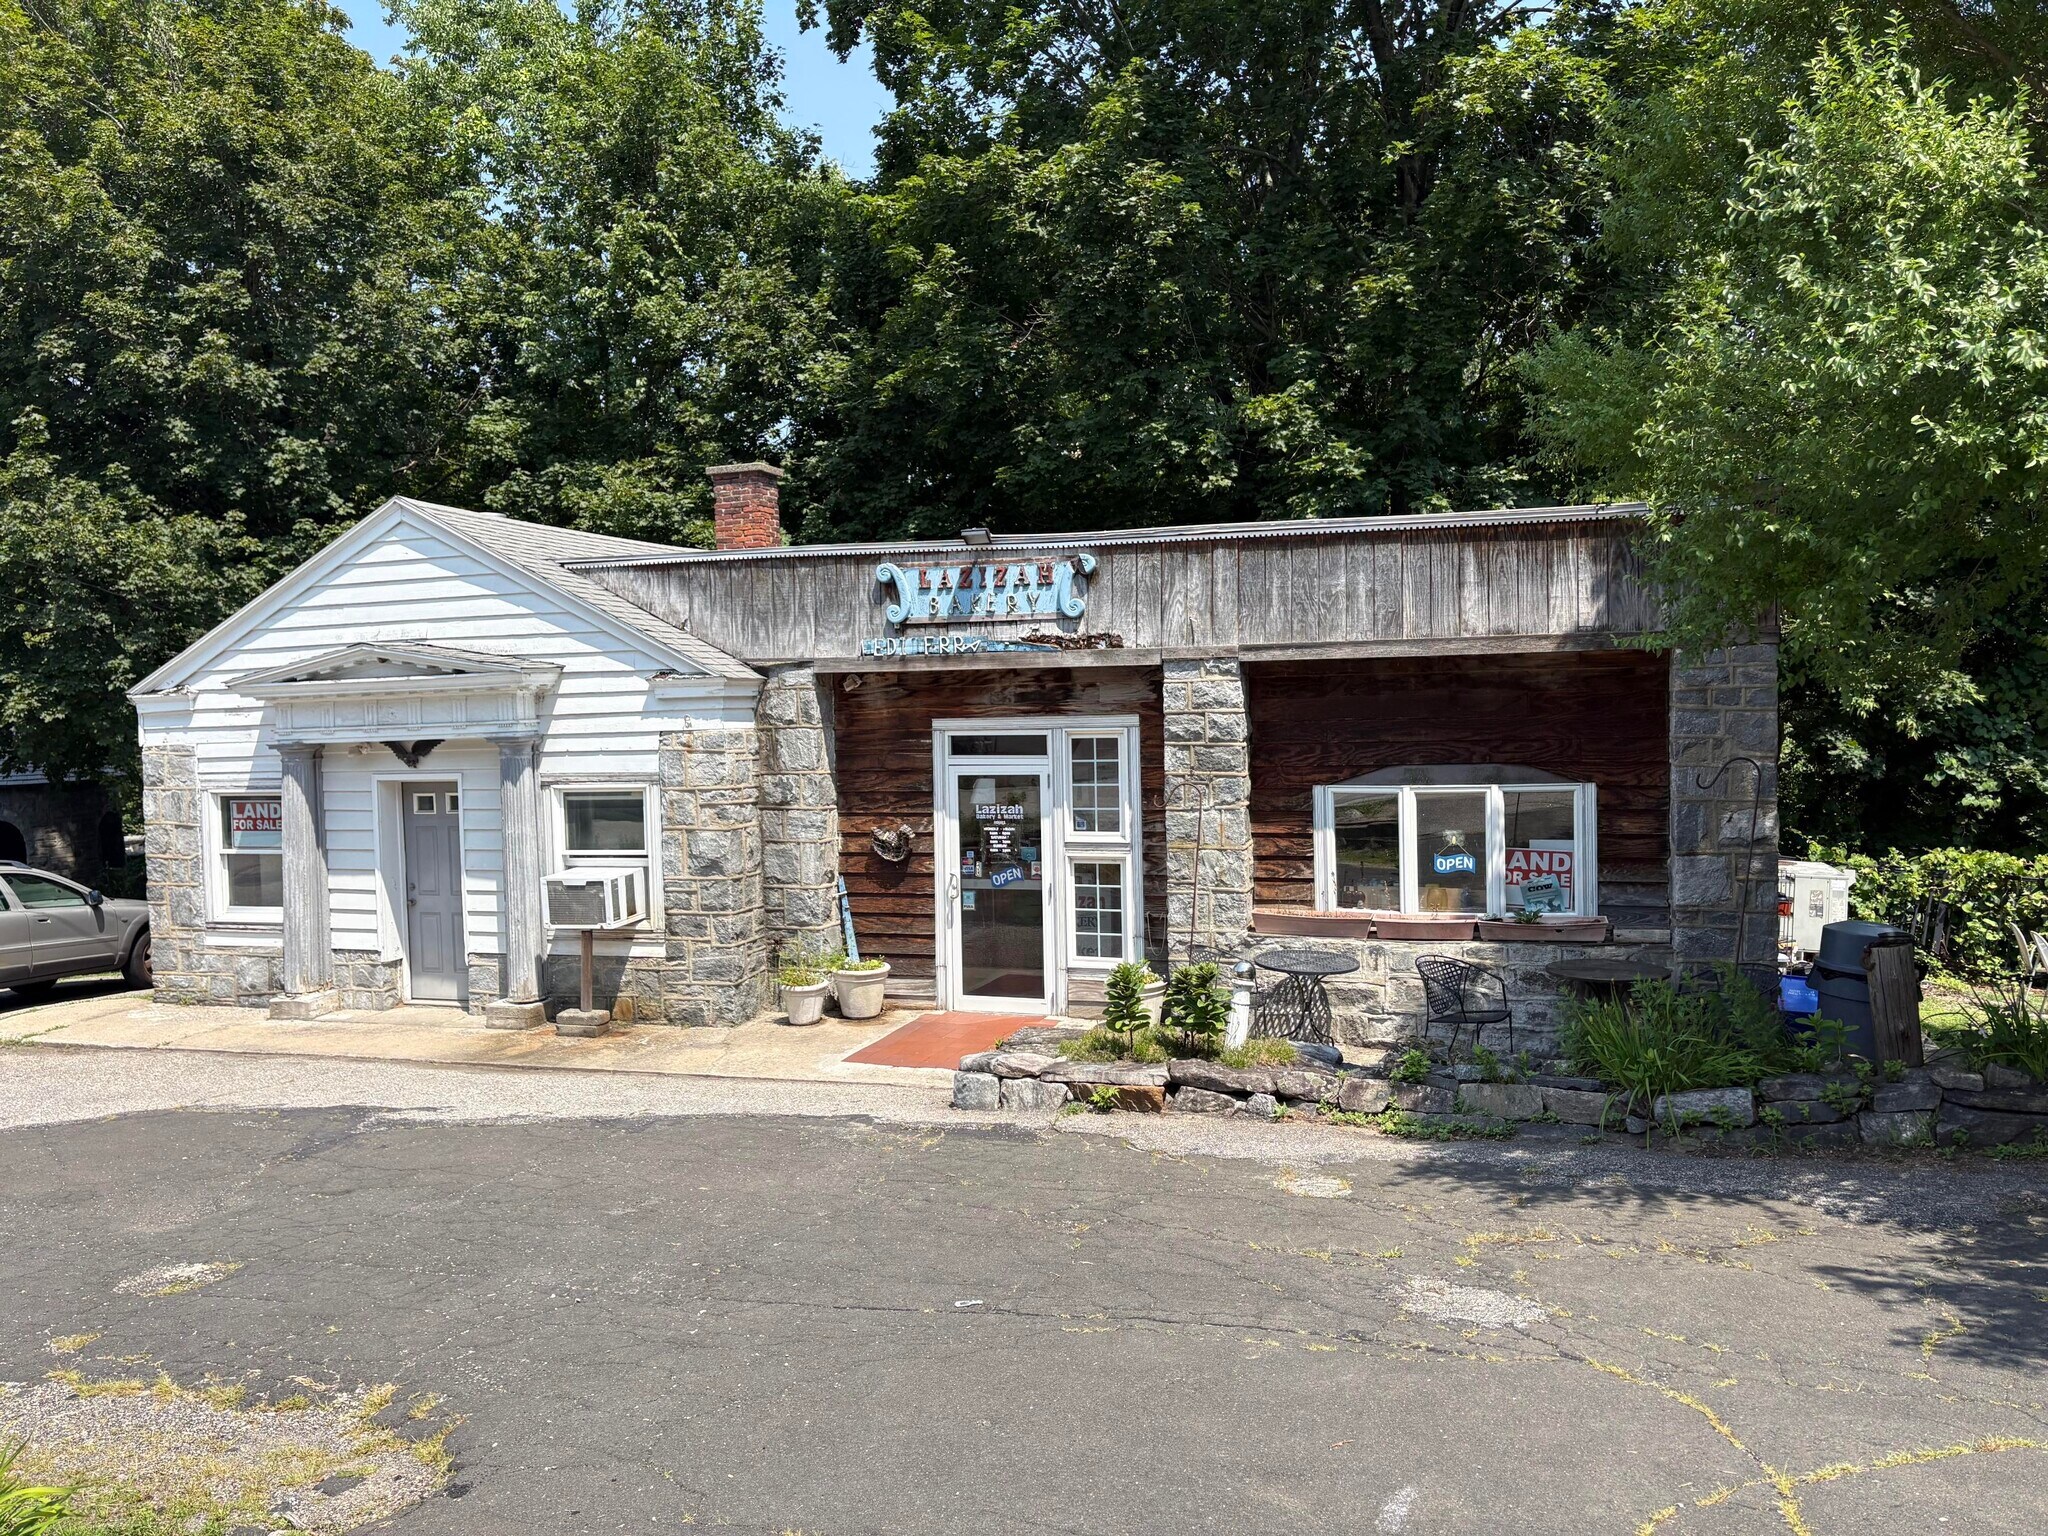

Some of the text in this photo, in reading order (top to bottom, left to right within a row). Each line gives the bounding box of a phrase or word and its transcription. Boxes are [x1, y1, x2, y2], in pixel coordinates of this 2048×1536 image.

[919, 562, 1055, 589] LAZIZAH
[929, 592, 1041, 615] BAKERY
[232, 803, 281, 819] LAND
[975, 803, 1024, 814] Lazizah
[233, 819, 282, 830] FOR SALE
[1436, 856, 1473, 870] OPEN
[1507, 851, 1571, 872] AND
[992, 867, 1022, 886] OPEN
[1505, 871, 1523, 884] OR
[1527, 883, 1553, 893] COW
